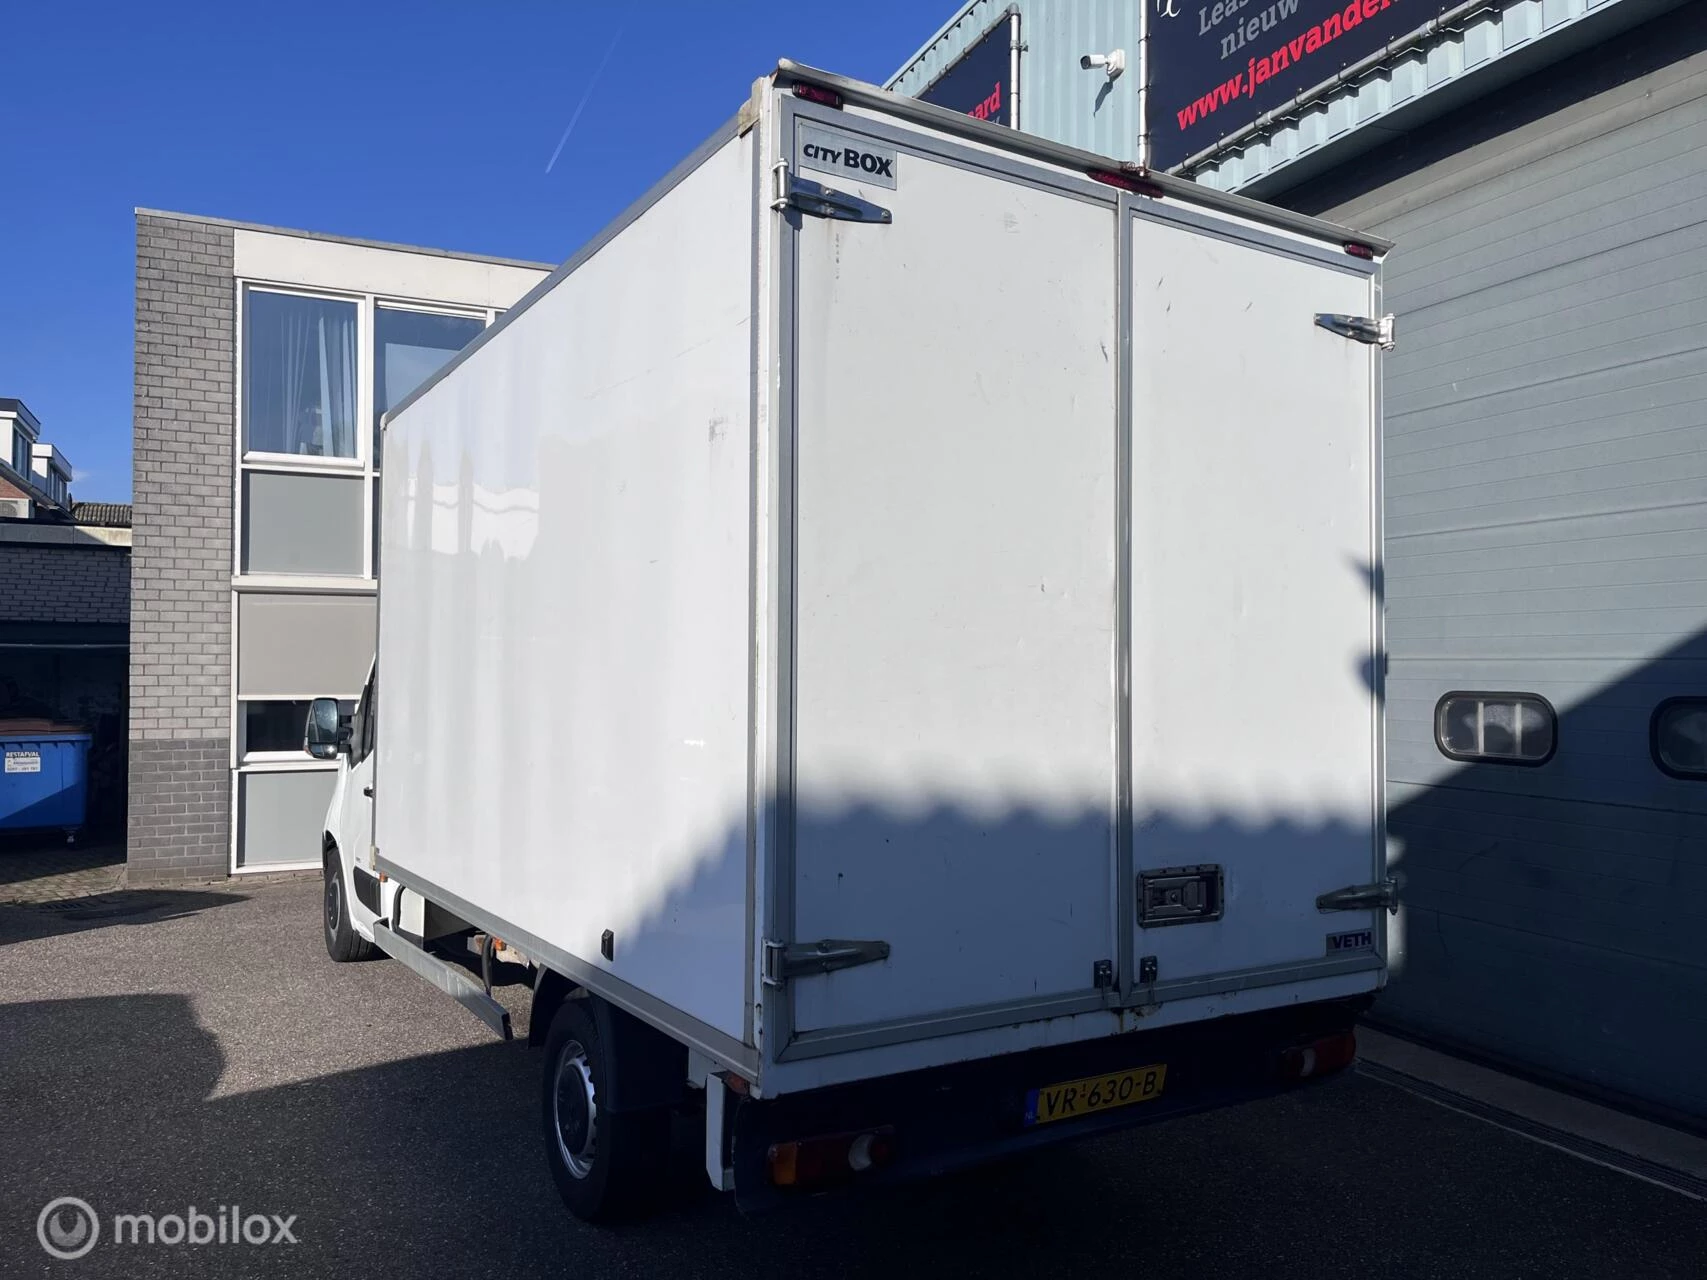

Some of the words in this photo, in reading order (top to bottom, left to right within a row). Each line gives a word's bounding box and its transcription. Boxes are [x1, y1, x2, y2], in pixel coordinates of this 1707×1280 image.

[1220, 0, 1299, 60] nieuw
[803, 143, 842, 164] CITY
[844, 147, 893, 178] BOX
[1332, 931, 1372, 949] VETH
[1045, 1071, 1157, 1116] VR-630-B
